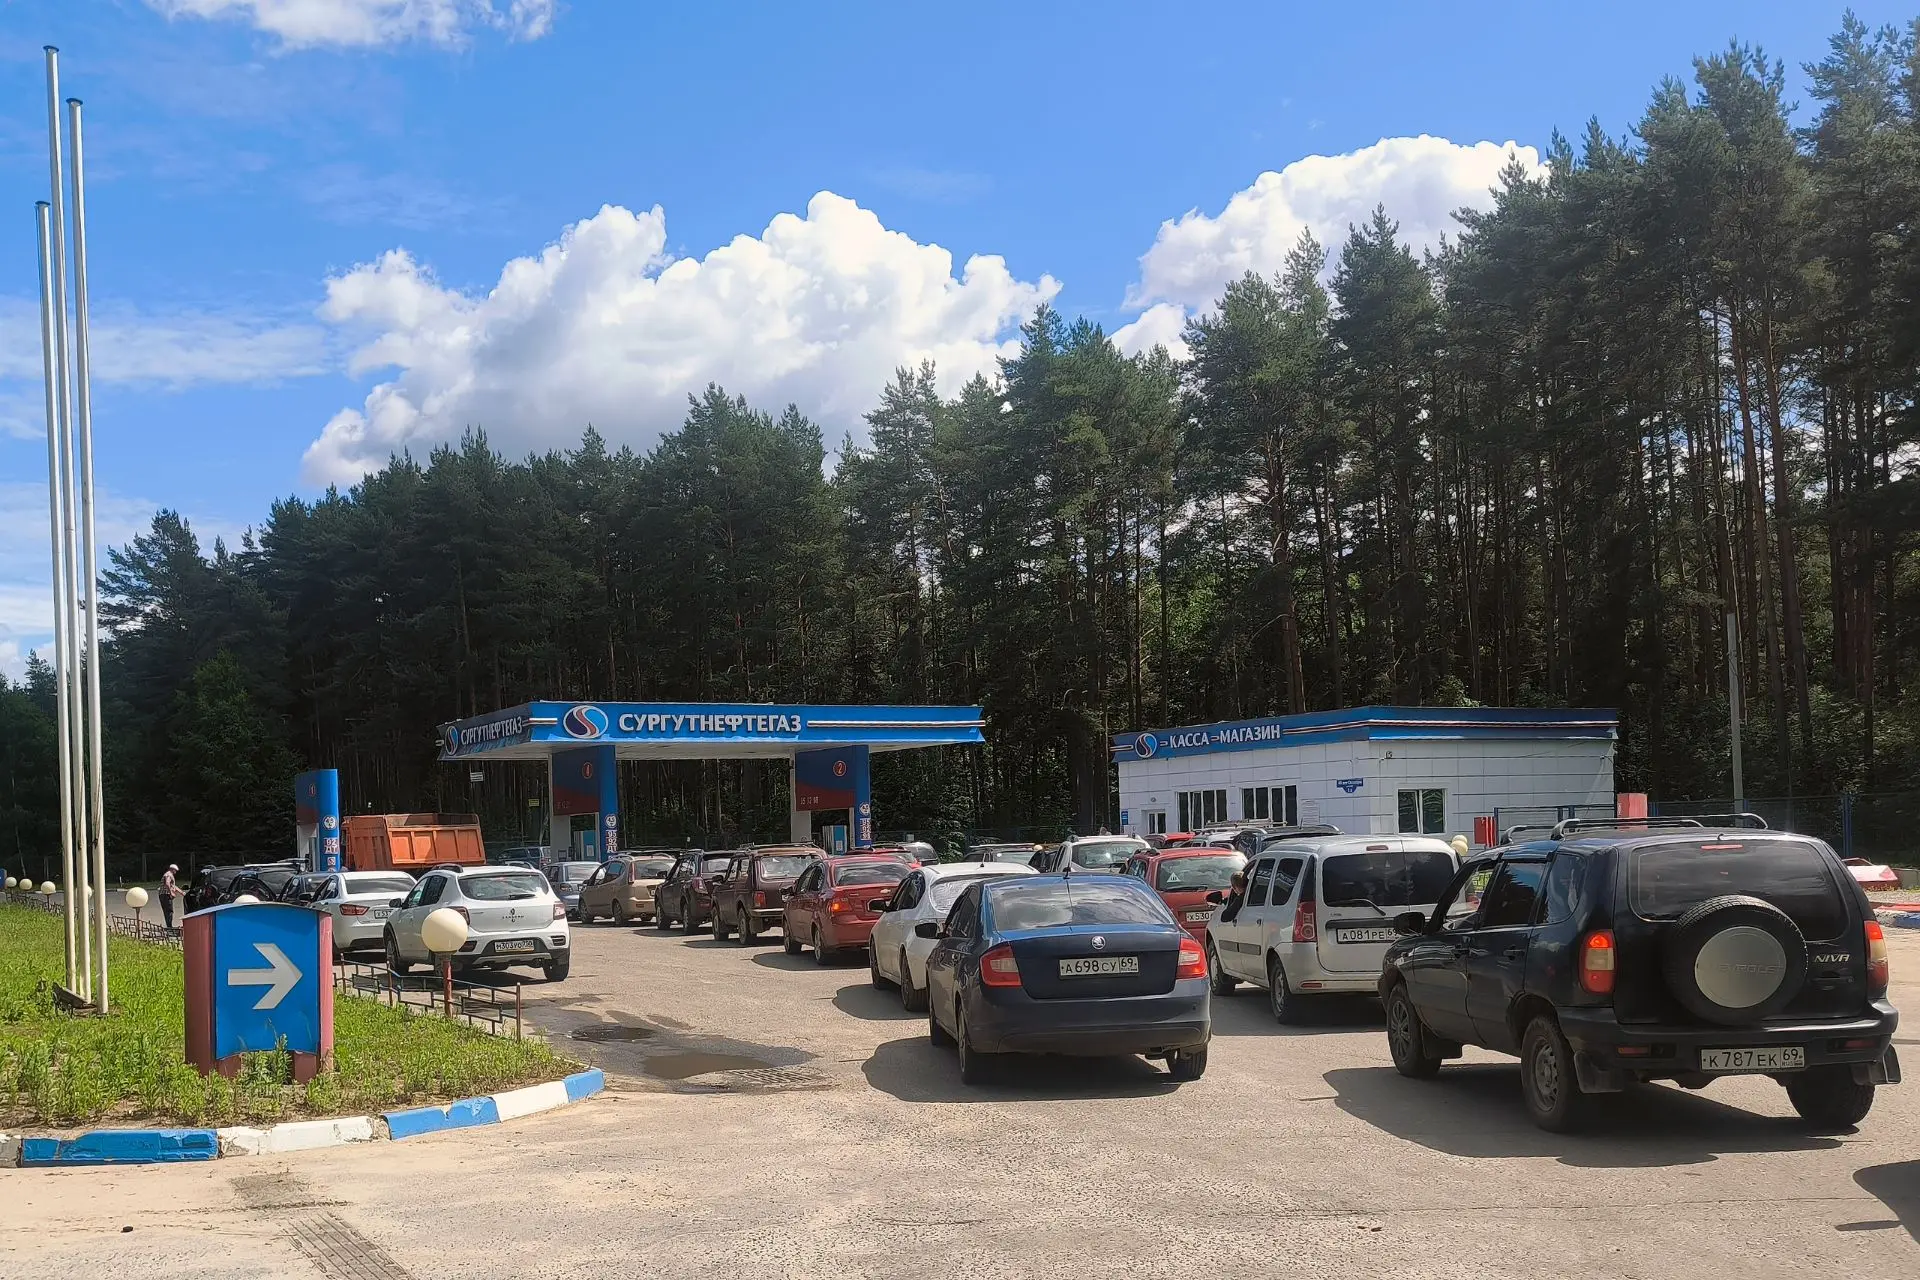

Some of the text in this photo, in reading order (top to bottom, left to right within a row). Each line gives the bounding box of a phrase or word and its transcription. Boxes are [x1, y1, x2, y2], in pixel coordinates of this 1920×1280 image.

[461, 716, 523, 746] СУРГУТНЕФТЕГАЗ
[619, 713, 802, 733] СУРГУТНЕФТЕГАЗ
[1066, 957, 1134, 973] А698СУ 69
[1814, 954, 1850, 963] NIVA
[1709, 1048, 1799, 1067] К787ЕК 69
